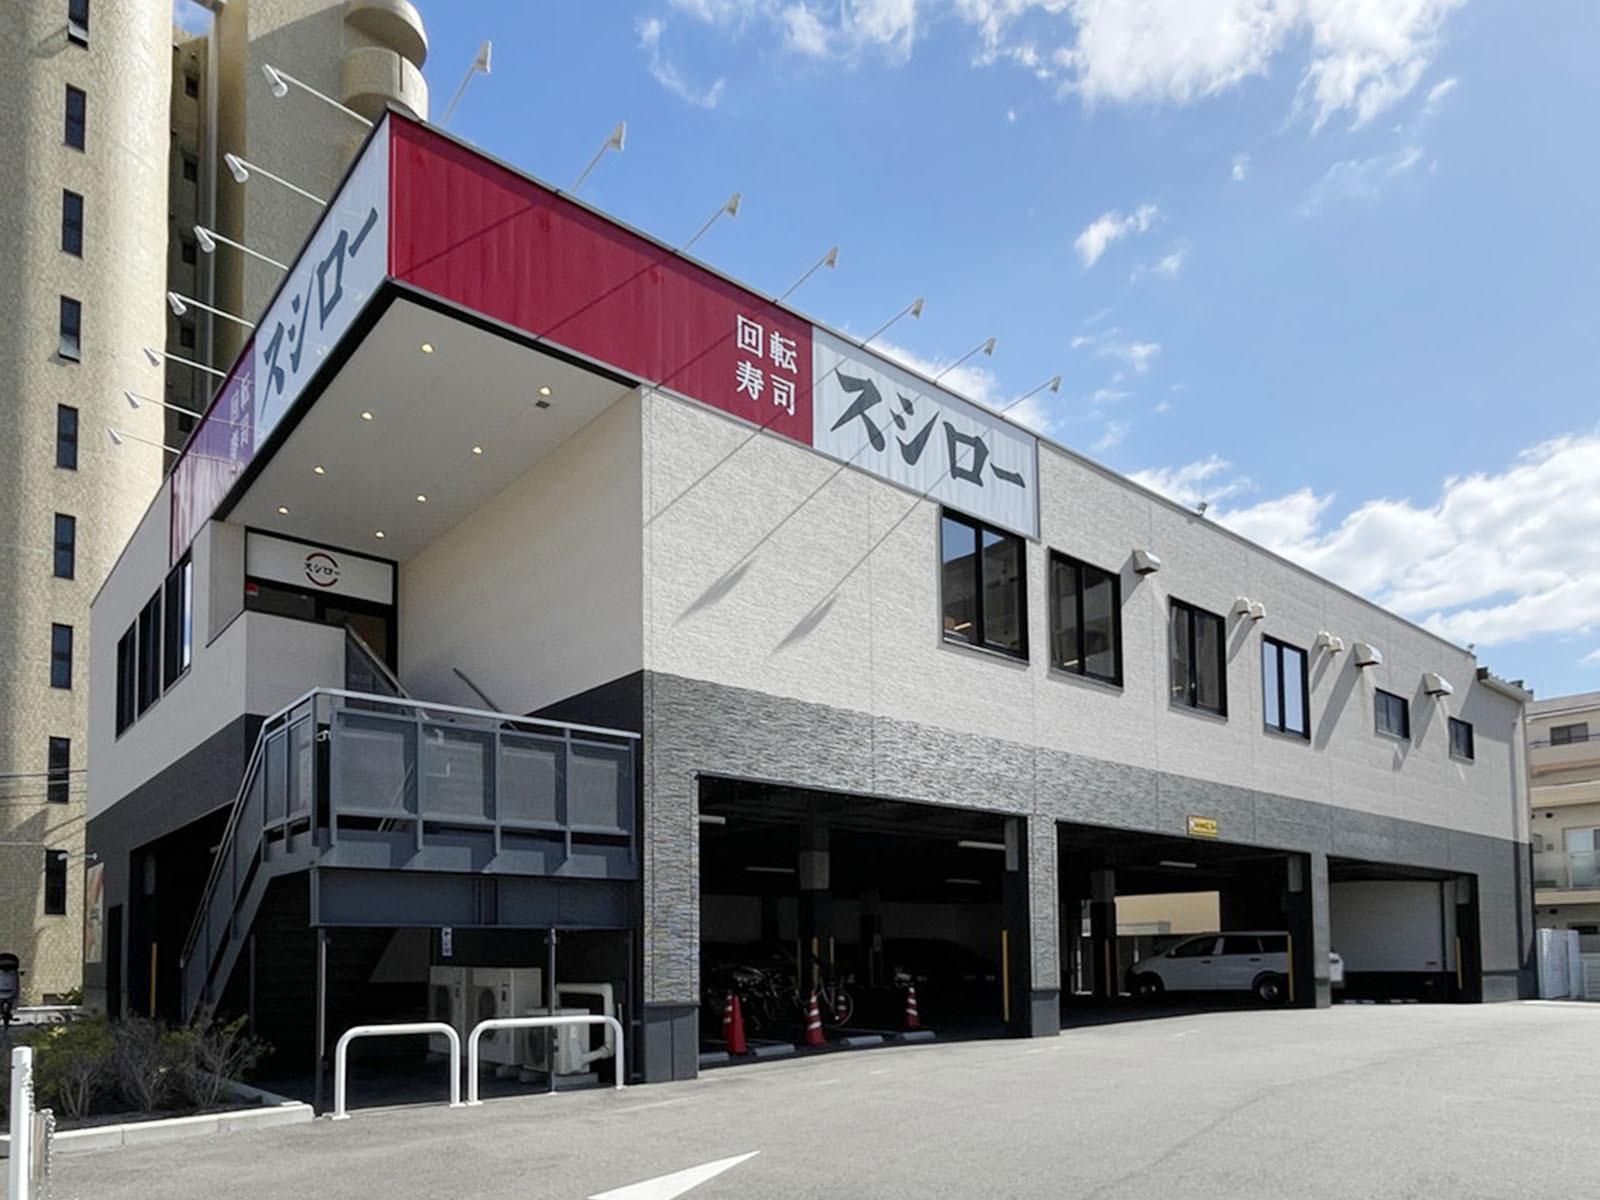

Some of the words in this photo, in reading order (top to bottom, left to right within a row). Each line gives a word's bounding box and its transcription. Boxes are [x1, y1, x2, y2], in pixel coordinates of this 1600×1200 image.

[260, 207, 378, 421] スシロー
[736, 314, 797, 374] 回転
[735, 360, 796, 416] 寿司
[830, 367, 1026, 488] スシロー
